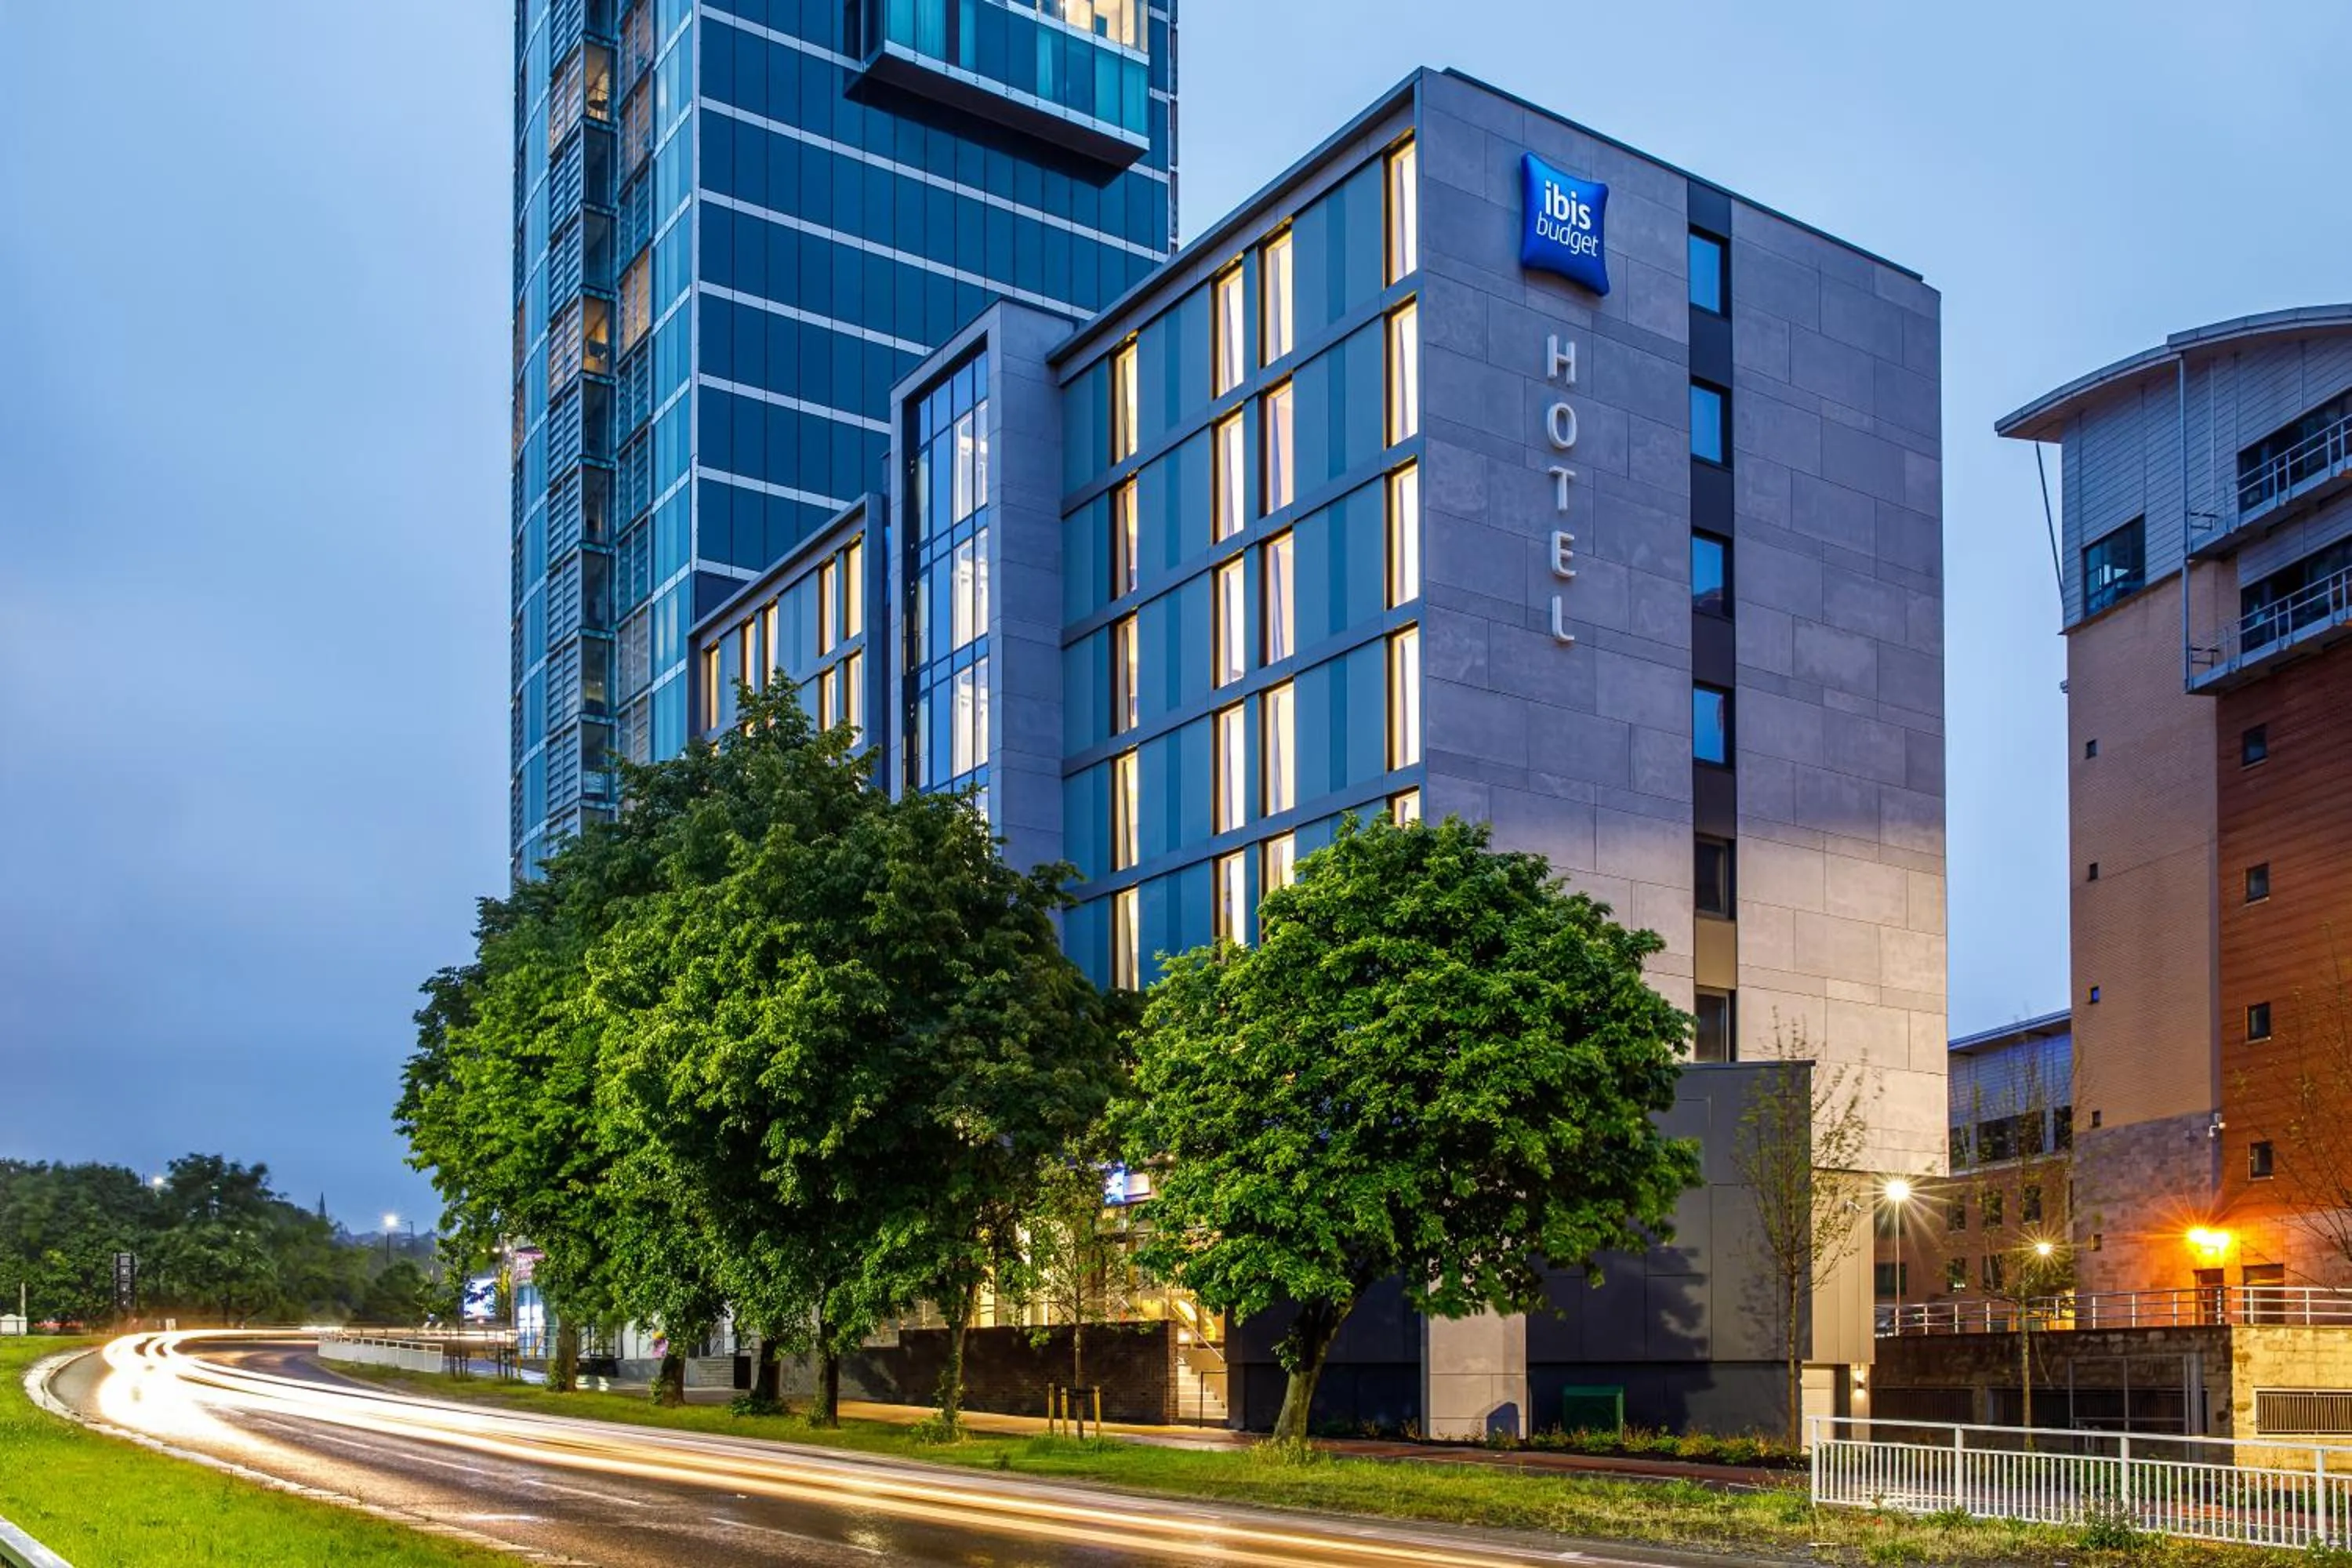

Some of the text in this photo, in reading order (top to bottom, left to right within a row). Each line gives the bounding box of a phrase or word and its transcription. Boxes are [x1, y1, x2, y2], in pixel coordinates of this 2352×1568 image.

[1545, 180, 1591, 230] ibis
[1536, 212, 1599, 256] budget
[1547, 334, 1577, 641] HOTEL
